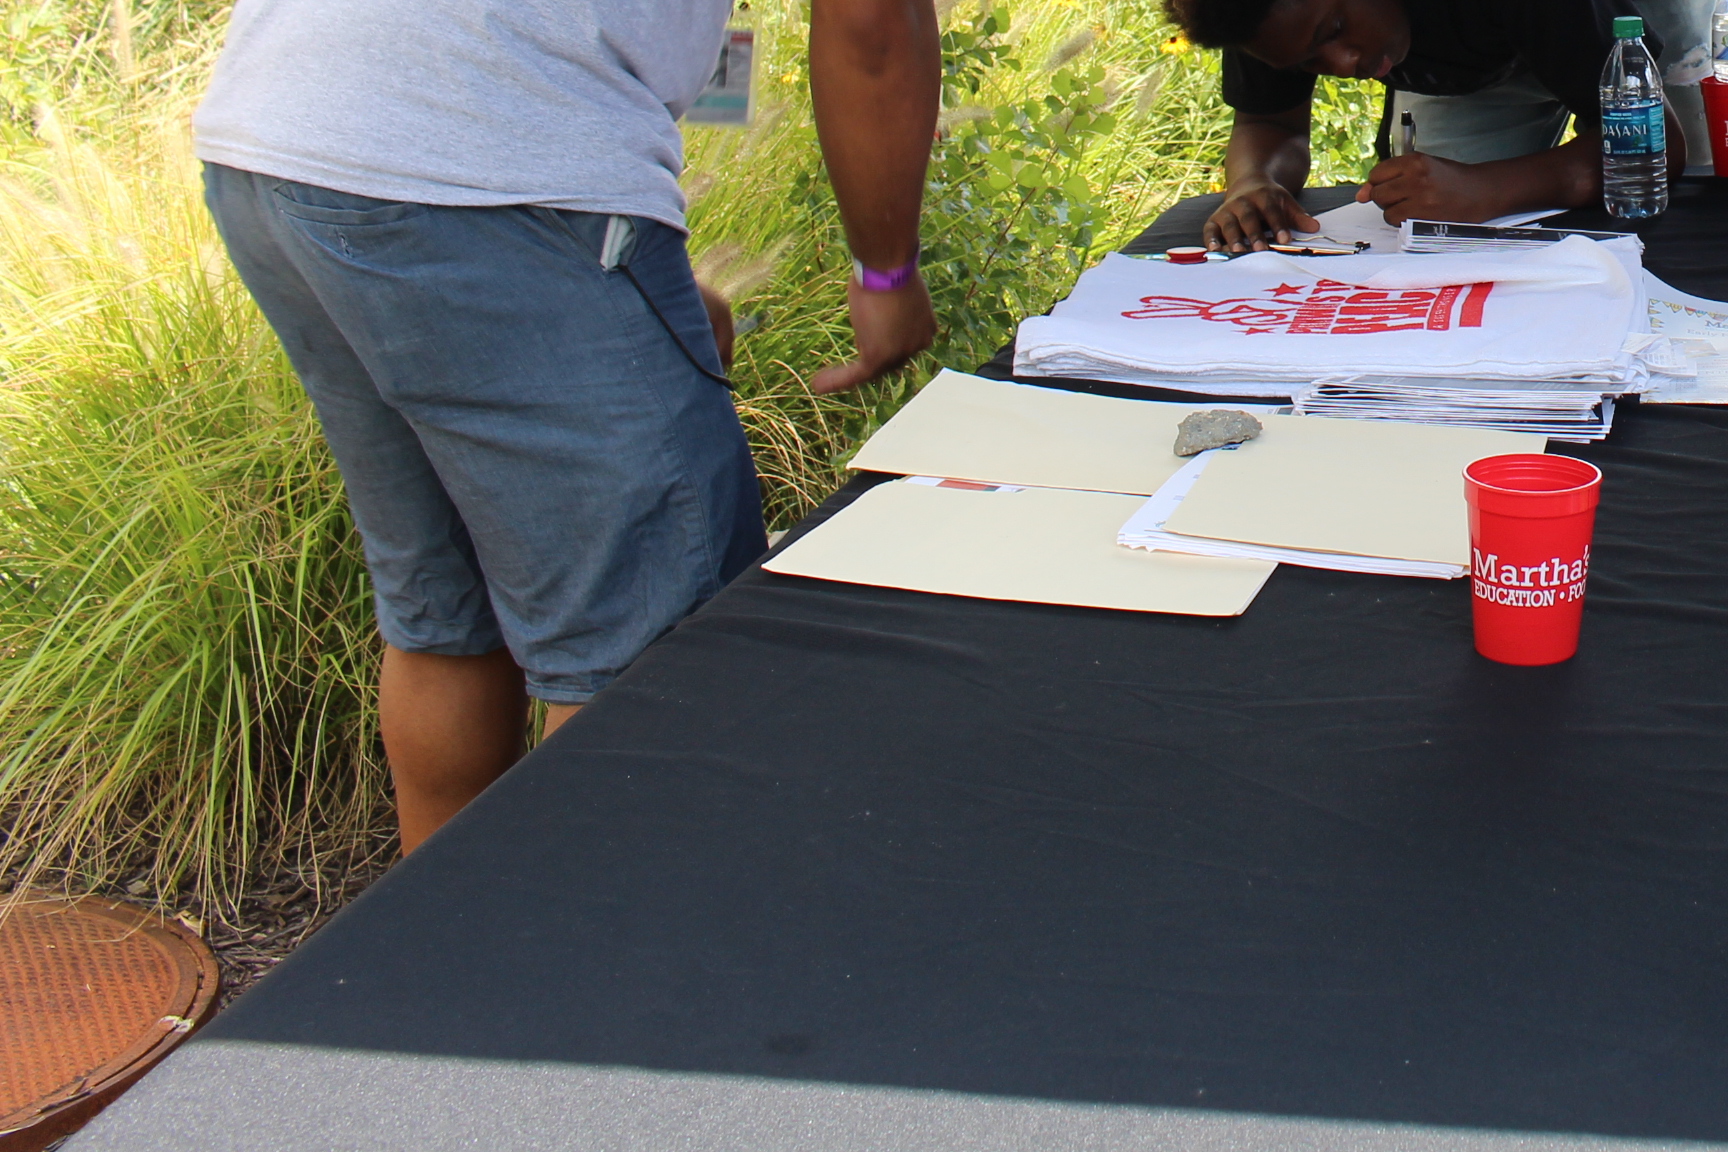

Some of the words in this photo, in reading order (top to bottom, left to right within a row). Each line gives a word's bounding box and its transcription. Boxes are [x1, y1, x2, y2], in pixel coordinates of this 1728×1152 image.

[1602, 122, 1647, 139] DASANI
[1330, 287, 1437, 335] PEAC
[1686, 328, 1718, 338] Early
[1474, 578, 1556, 608] EDUCATION
[1567, 578, 1587, 603] FOO
